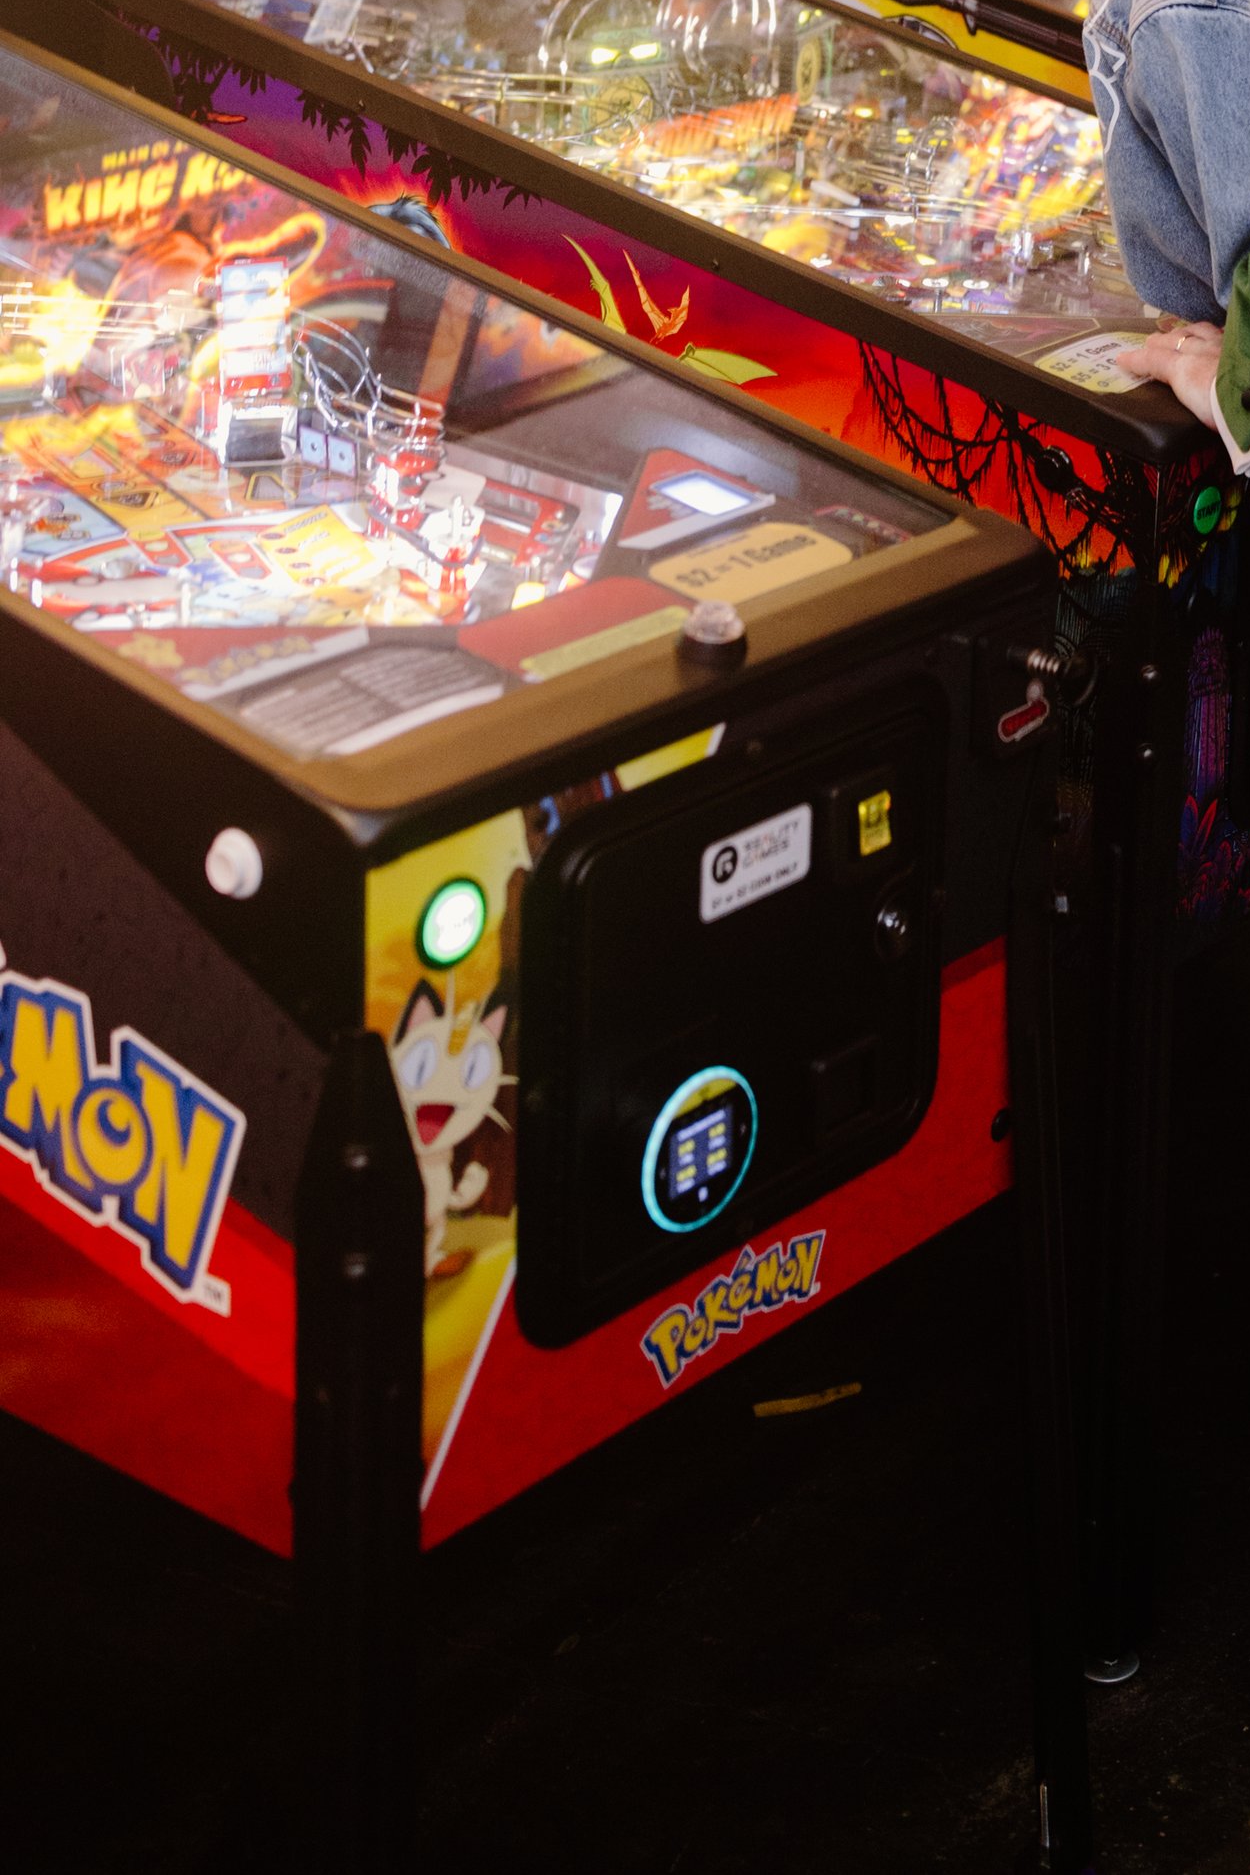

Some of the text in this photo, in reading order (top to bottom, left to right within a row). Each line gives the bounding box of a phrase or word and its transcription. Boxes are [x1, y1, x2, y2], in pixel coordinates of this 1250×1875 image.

[1085, 341, 1122, 356] Game
[1196, 501, 1221, 520] START
[676, 567, 713, 588] $2
[743, 533, 817, 563] Game
[0, 980, 238, 1290] MON
